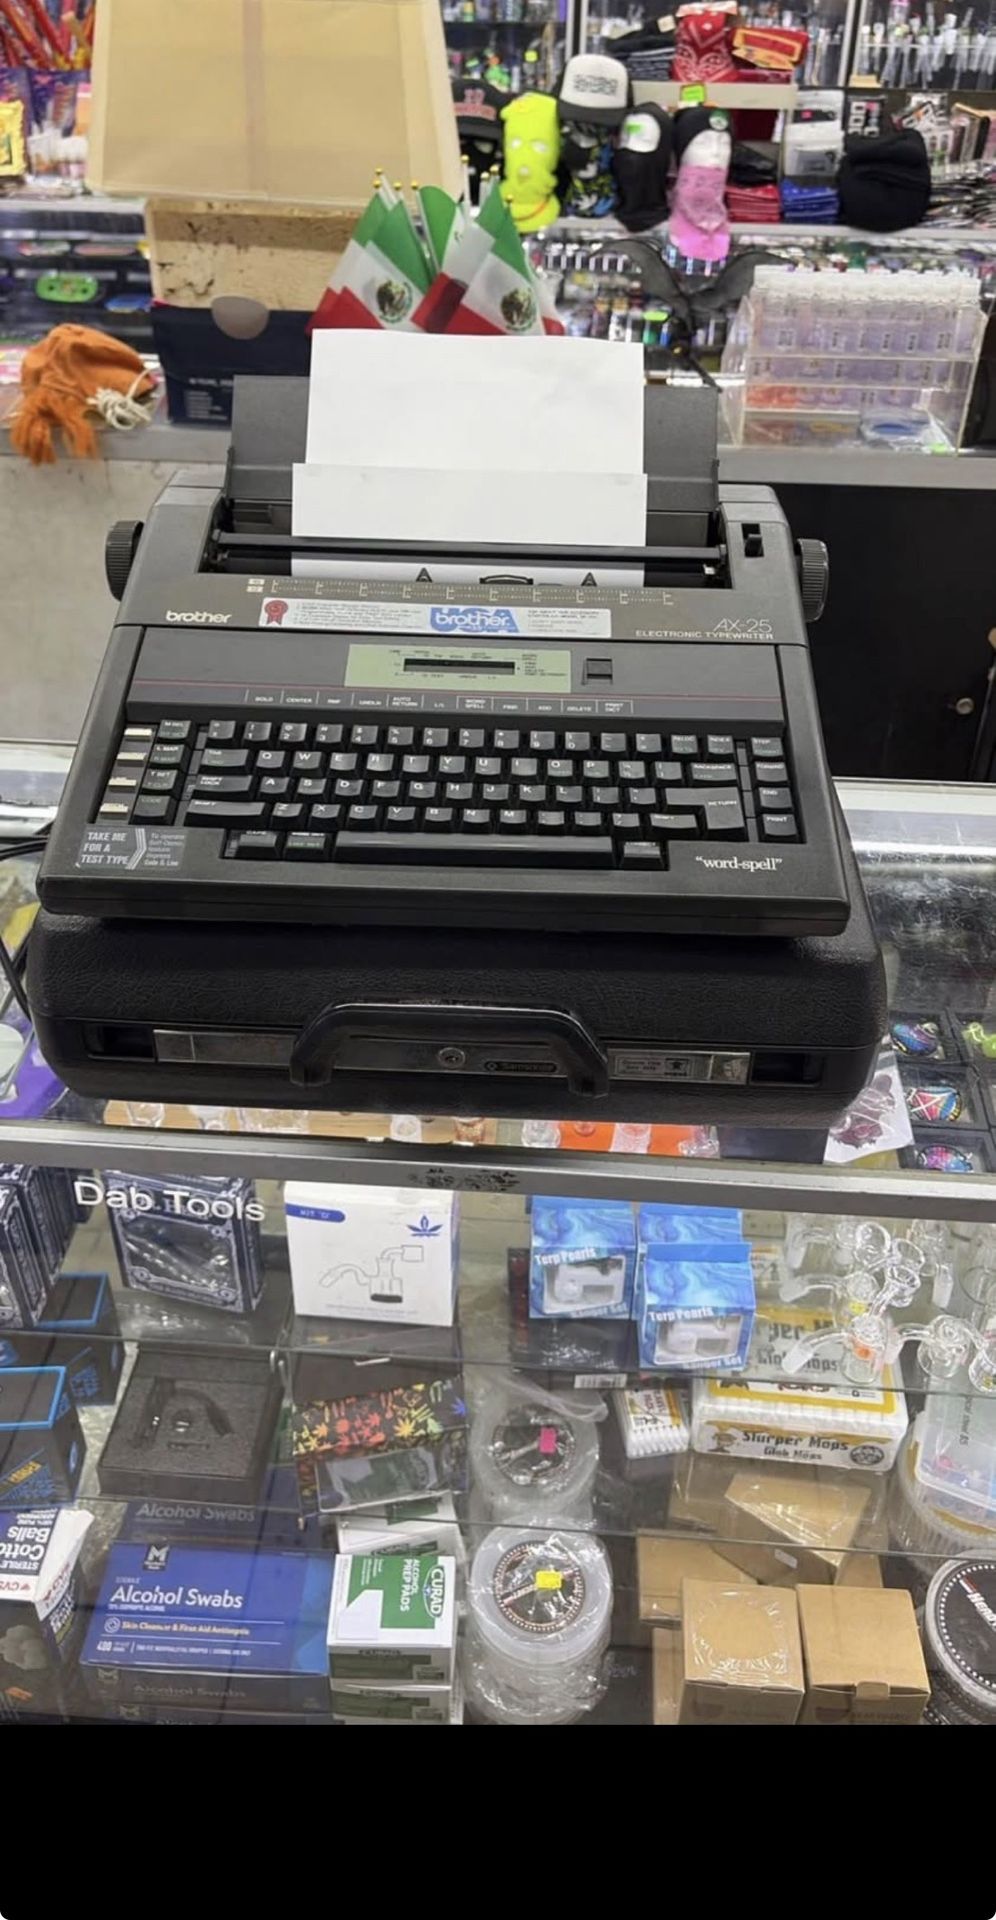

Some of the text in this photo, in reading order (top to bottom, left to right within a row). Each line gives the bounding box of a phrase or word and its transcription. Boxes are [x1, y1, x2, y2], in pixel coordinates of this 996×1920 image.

[166, 610, 232, 623] brother
[712, 618, 773, 633] AX-25
[635, 630, 774, 640] ELECTRONIC TYPEWRITER
[87, 831, 128, 842] TAKE ME
[83, 842, 111, 853] FOR A
[80, 854, 130, 865] TEST TYPE
[74, 1181, 154, 1212] Dab
[163, 1190, 266, 1221] Tools
[534, 1247, 597, 1266] Terp Pearls
[648, 1306, 715, 1323] Terp Pearls
[742, 1431, 849, 1451] Slurper Mops
[763, 1446, 822, 1461] Glob Mops
[136, 1502, 256, 1522] Alcohol Swabs
[7, 1526, 50, 1543] Balls
[2, 1559, 39, 1571] STERILE
[400, 1558, 412, 1612] PREP PADS
[411, 1558, 420, 1595] ALCOHOL
[110, 1584, 244, 1608] Alcohol Swabs
[430, 1568, 444, 1615] CURAD
[121, 1620, 138, 1630] Skin
